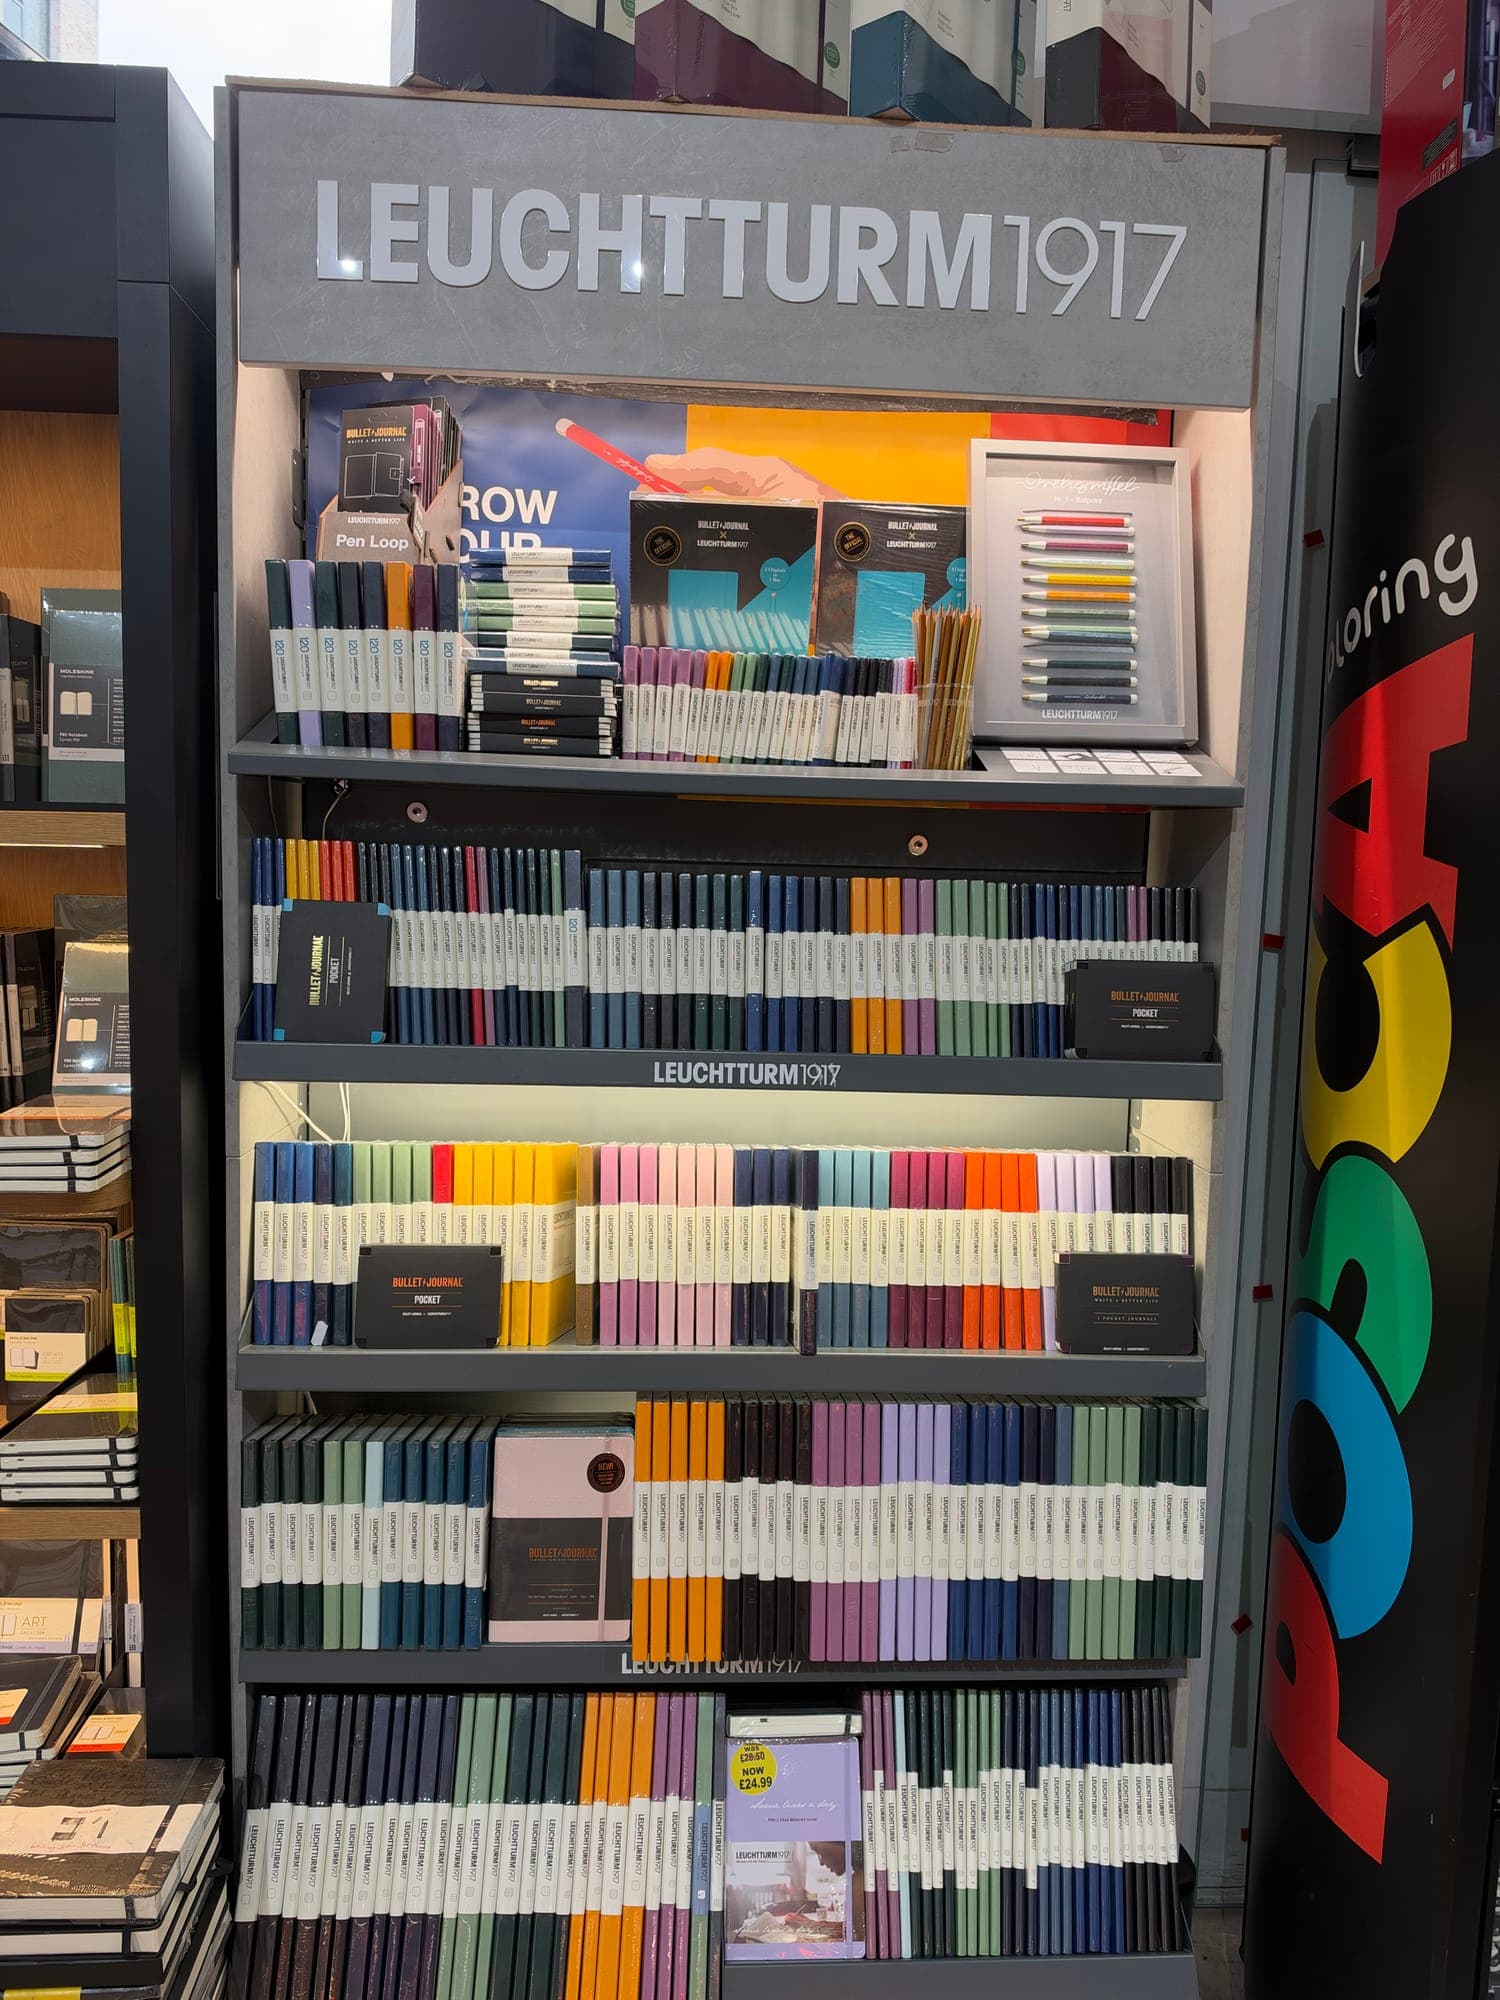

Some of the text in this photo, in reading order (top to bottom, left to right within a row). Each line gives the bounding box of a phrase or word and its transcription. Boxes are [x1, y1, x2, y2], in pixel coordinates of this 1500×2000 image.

[316, 180, 1189, 322] LEUCHTTURM1917
[336, 535, 408, 551] Pen Loop
[275, 640, 284, 656] 120
[300, 637, 310, 653] 120
[325, 637, 334, 653] 120
[348, 640, 358, 655] 120
[369, 638, 379, 653] 120
[393, 640, 403, 654] 120
[420, 640, 429, 655] 120
[444, 643, 453, 658] 120
[1042, 709, 1118, 720] LEUCHTTURM1917
[568, 918, 577, 933] 120
[329, 958, 339, 983] POCKET
[1111, 991, 1179, 1002] BULLET JOURNAL
[1133, 1009, 1159, 1017] POCKET
[655, 1061, 841, 1087] LEUCHTTURM1917
[392, 1277, 463, 1287] BULLET JOURNAL
[415, 1295, 441, 1304] POCKET
[1093, 1286, 1160, 1297] BULLET JOURNAL
[247, 1518, 255, 1565] LEUCHTTURM1917
[268, 1513, 276, 1560] LEUCHTTURM1917
[289, 1514, 297, 1562] LEUCHTTURM1917
[329, 1514, 337, 1562] LEUCHTTURM1917
[529, 1548, 557, 1558] BULLET
[21, 1616, 47, 1627] ART
[742, 1766, 764, 1776] NOW
[740, 1777, 772, 1790] £24.99
[385, 1818, 396, 1876] LEUCHTTURM1917
[637, 1814, 645, 1876] LEUCHTTURM1917
[670, 1811, 678, 1868] LEUCHTTURM1917
[246, 1825, 259, 1889] LEUCHTTURM1917
[271, 1819, 284, 1884] LEUCHTTURM1917
[309, 1824, 321, 1888] LEUCHTTURM1917
[362, 1822, 374, 1886] LEUCHTTURM1917
[416, 1818, 428, 1882] LEUCHTTURM1917
[453, 1824, 463, 1882] LEUCHTTURM1917
[508, 1820, 519, 1883] LEUCHTTURM1917
[547, 1819, 556, 1882] LEUCHTTURM1917
[614, 1822, 622, 1885] LEUCHTTURM1917
[700, 1822, 709, 1883] LEUCHTTURM1917
[736, 1851, 789, 1859] LEUCHTTURM1917
